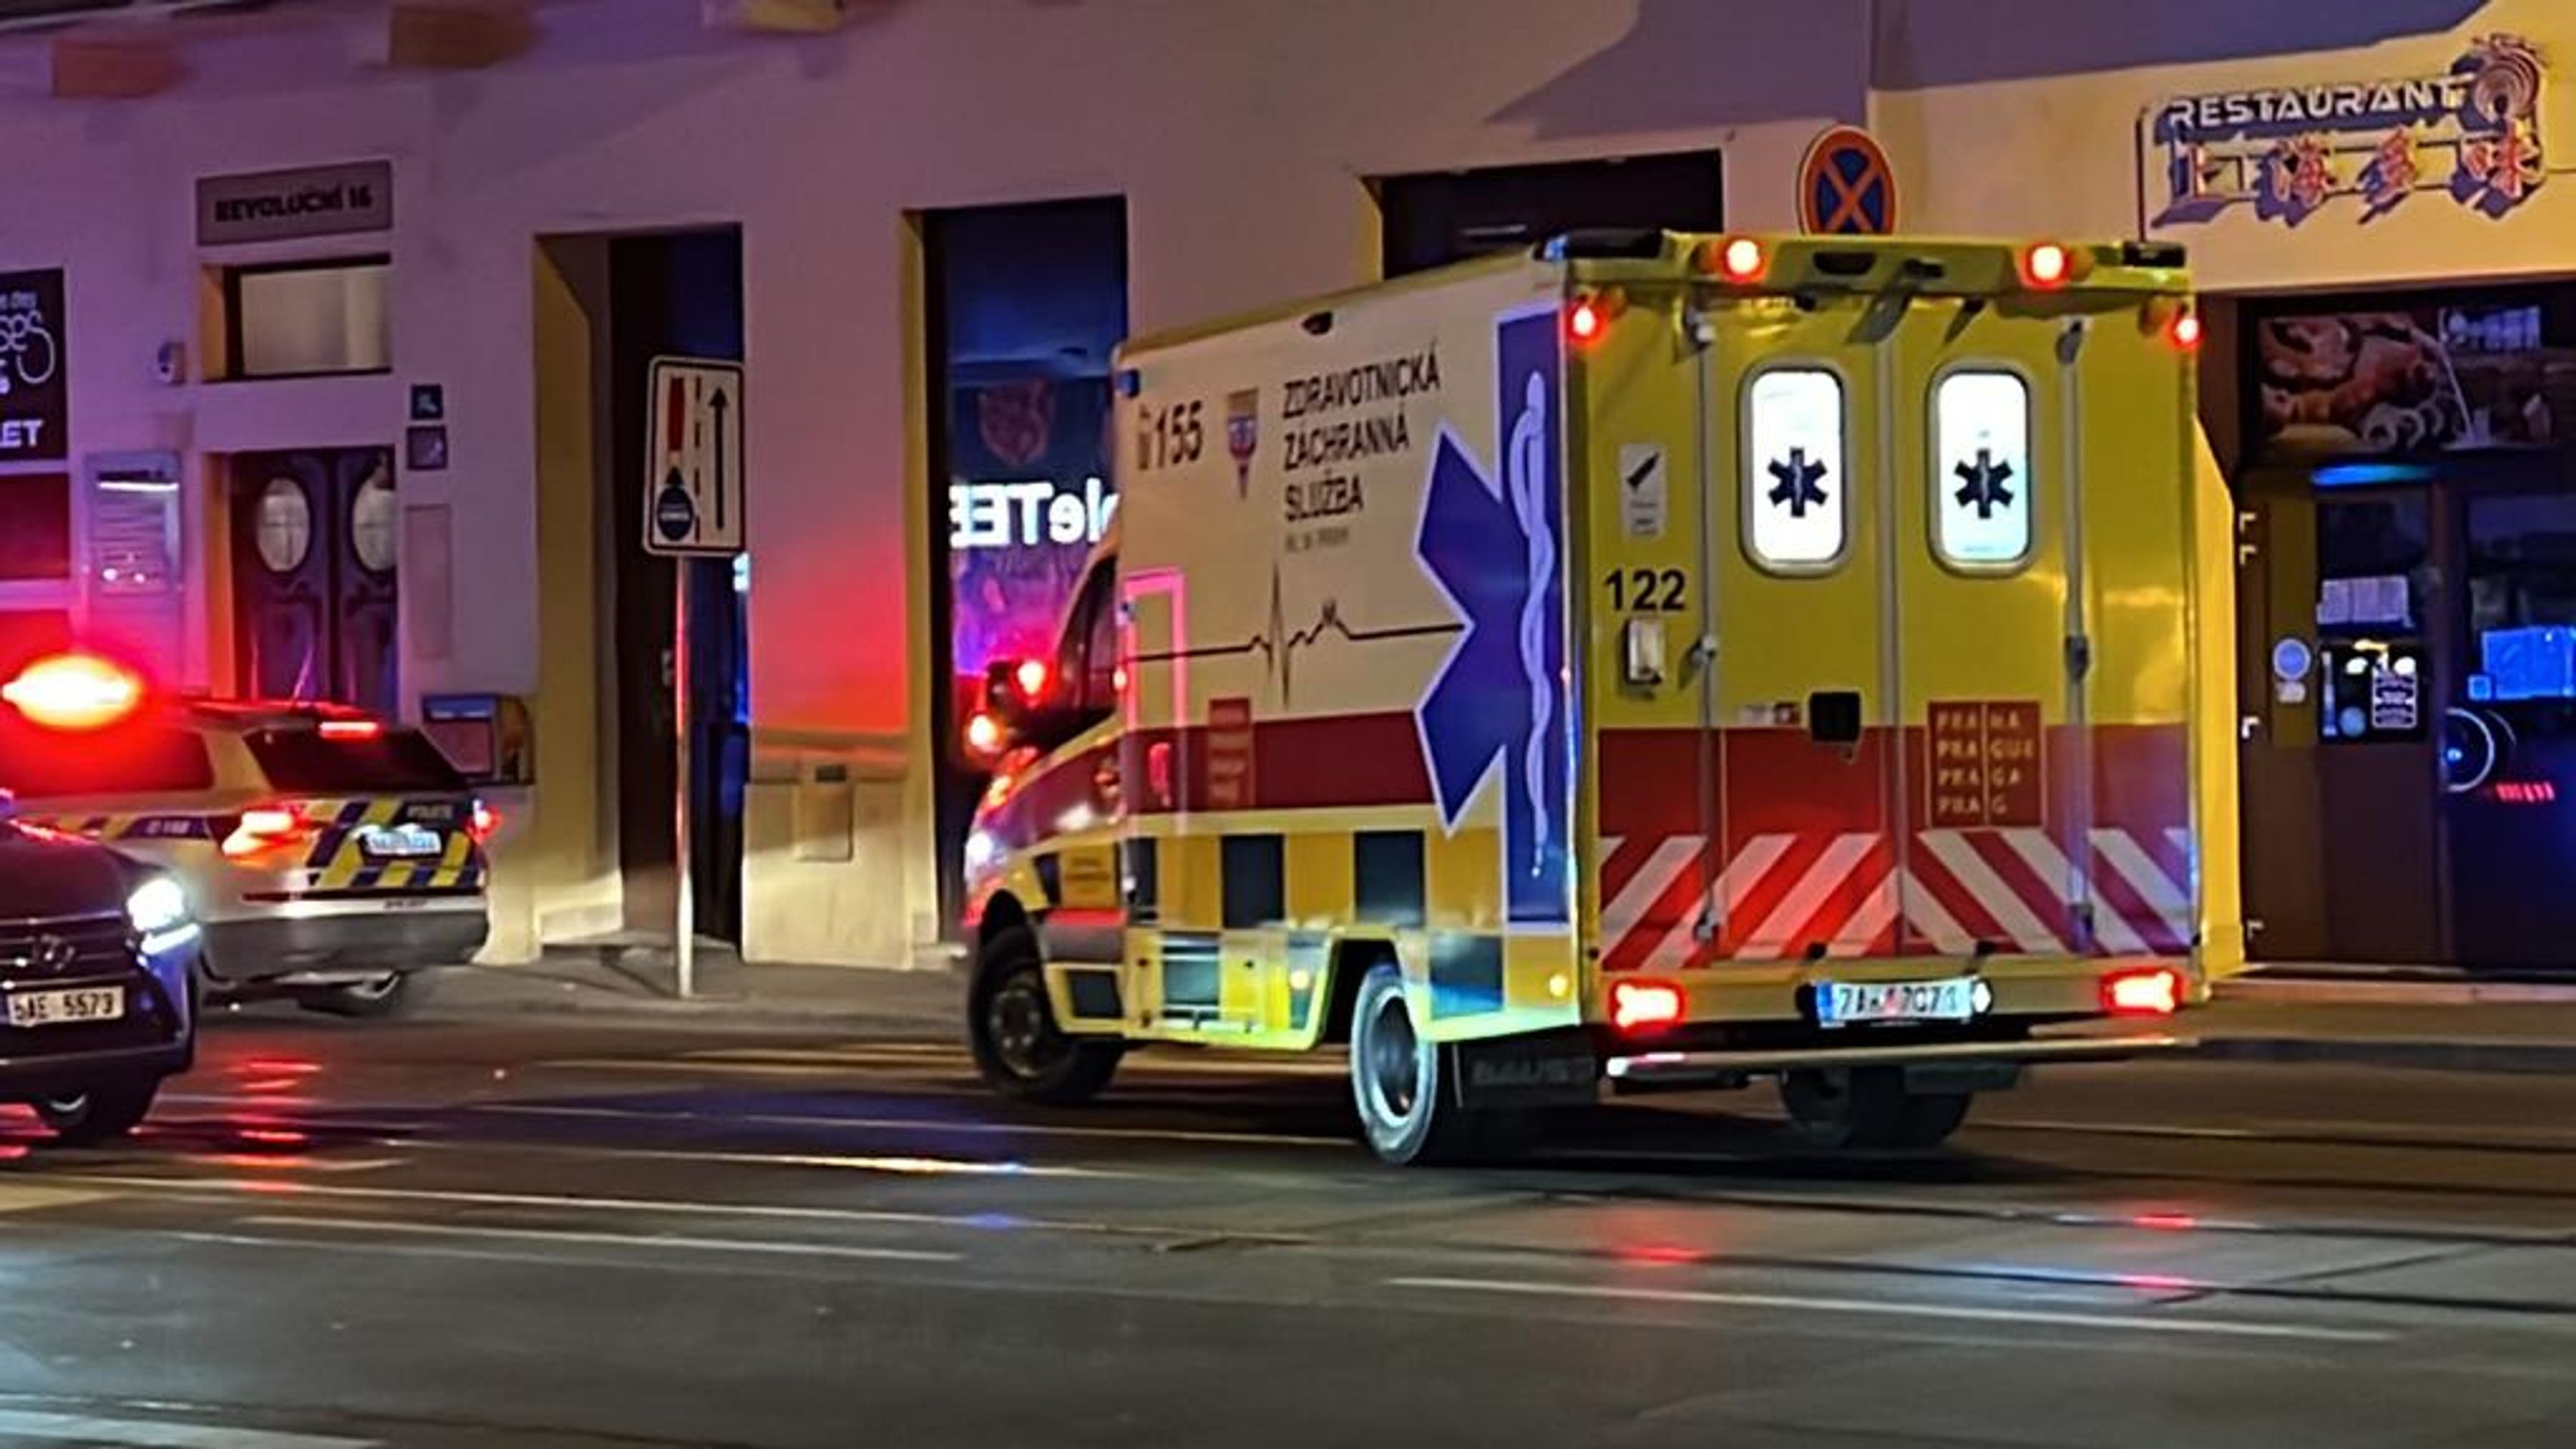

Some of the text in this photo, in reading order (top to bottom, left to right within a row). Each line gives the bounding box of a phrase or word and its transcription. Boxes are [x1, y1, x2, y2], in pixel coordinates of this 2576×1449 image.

[2168, 74, 2474, 128] RESTAURANT
[1283, 340, 1440, 419] ZDRAVOTNICKÁ
[1156, 400, 1203, 468] 155
[1605, 569, 1686, 611] 122
